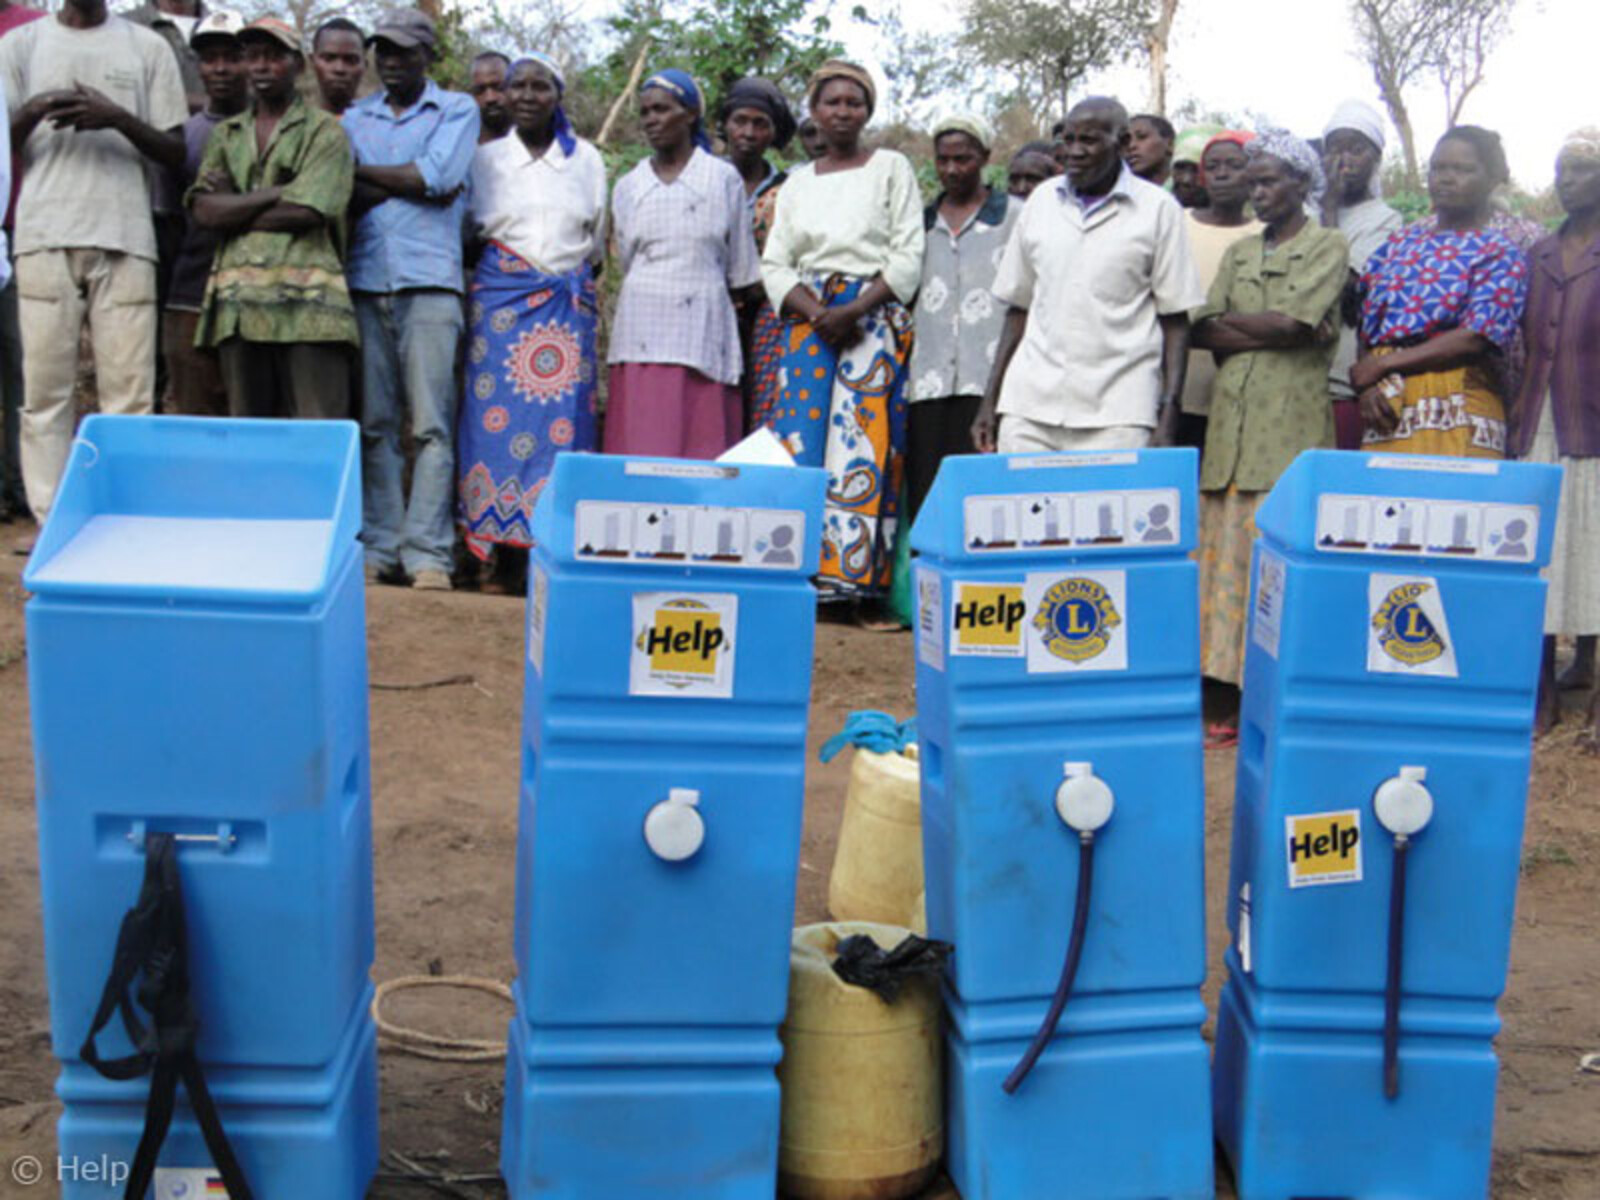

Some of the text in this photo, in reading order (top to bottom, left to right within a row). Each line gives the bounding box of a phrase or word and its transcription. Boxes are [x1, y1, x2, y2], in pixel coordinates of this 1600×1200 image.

[954, 594, 1026, 634] Help
[1067, 604, 1090, 634] L
[1404, 607, 1426, 637] L
[647, 620, 724, 660] Help
[1289, 823, 1359, 864] Help
